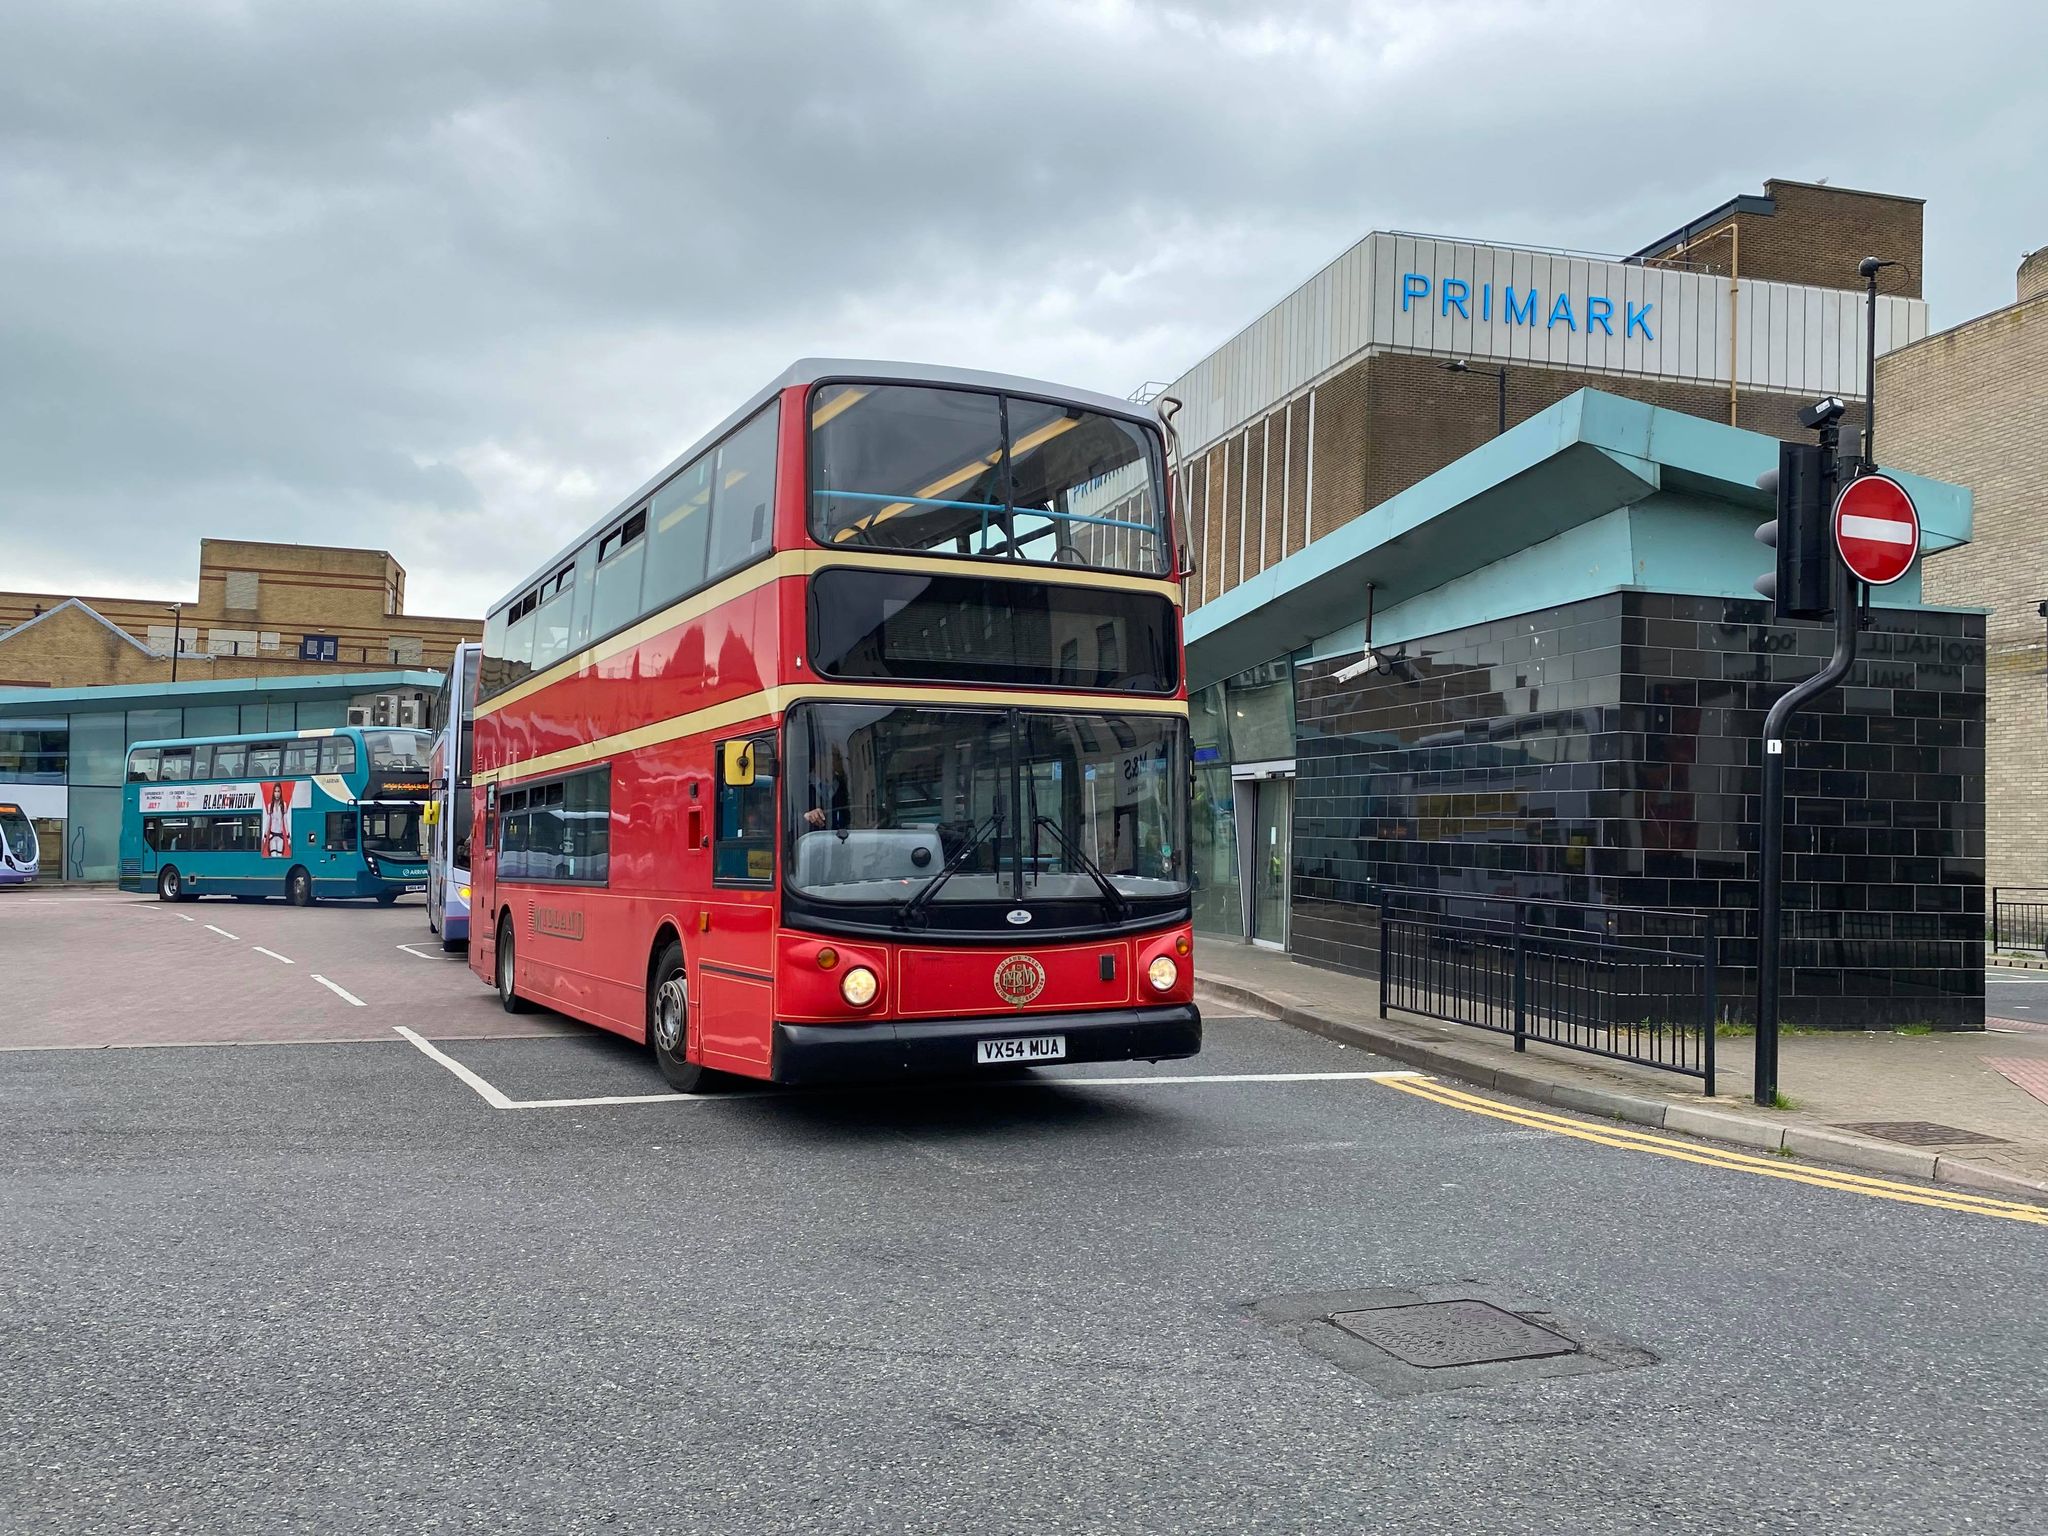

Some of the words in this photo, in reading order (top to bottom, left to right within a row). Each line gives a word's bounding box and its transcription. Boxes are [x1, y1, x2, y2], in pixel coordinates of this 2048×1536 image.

[1403, 273, 1654, 340] PRIMARK
[203, 794, 227, 810] BLACK
[229, 792, 256, 809] WIDOW
[984, 1042, 1024, 1059] VX54
[1030, 1039, 1059, 1056] MUA
